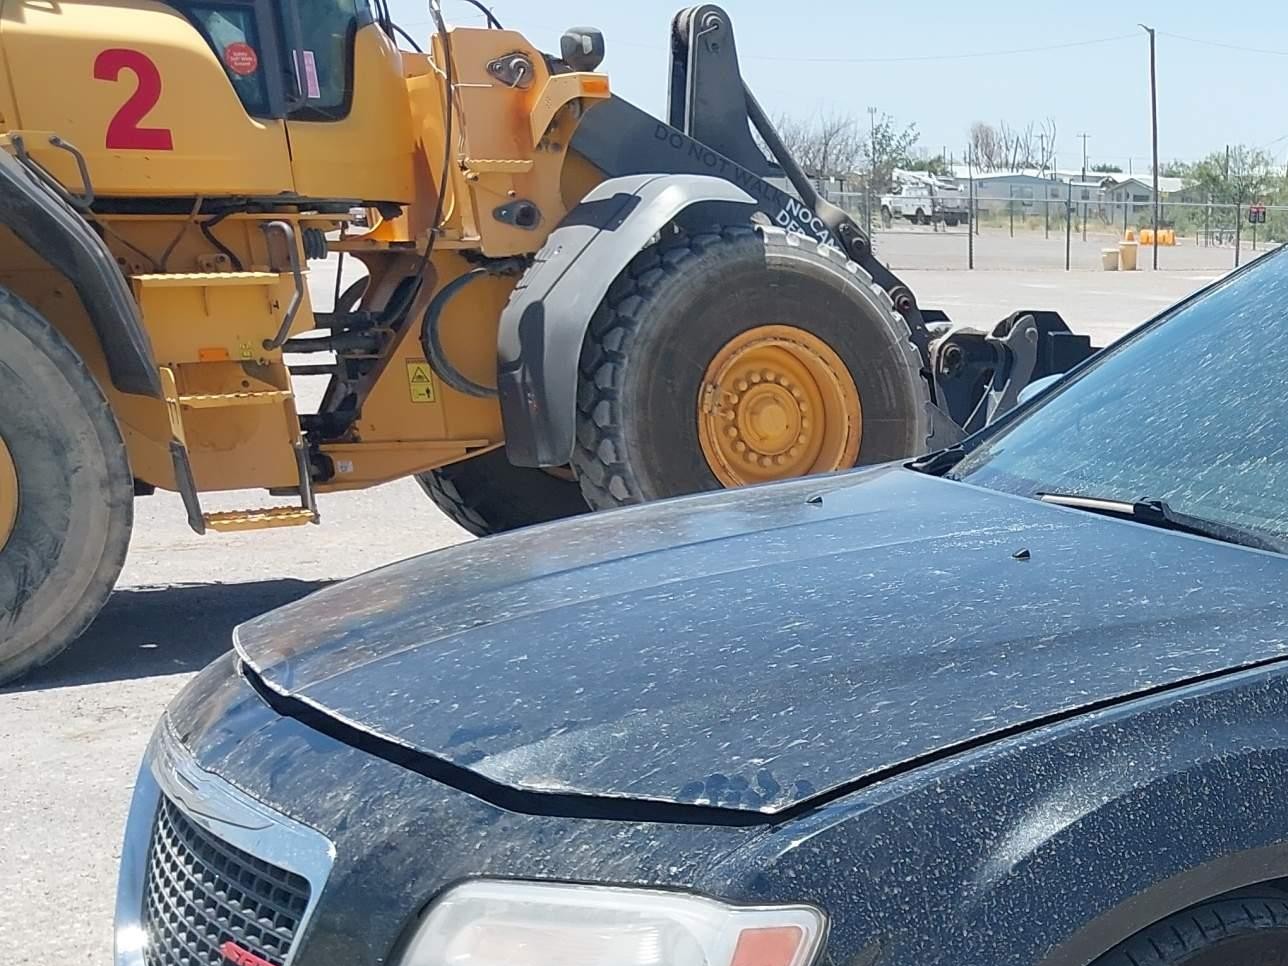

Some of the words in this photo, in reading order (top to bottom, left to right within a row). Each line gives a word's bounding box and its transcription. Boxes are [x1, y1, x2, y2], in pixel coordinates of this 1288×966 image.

[94, 48, 173, 150] 2
[655, 124, 684, 149] DO
[687, 141, 730, 174] NOT
[735, 166, 786, 207] WALK
